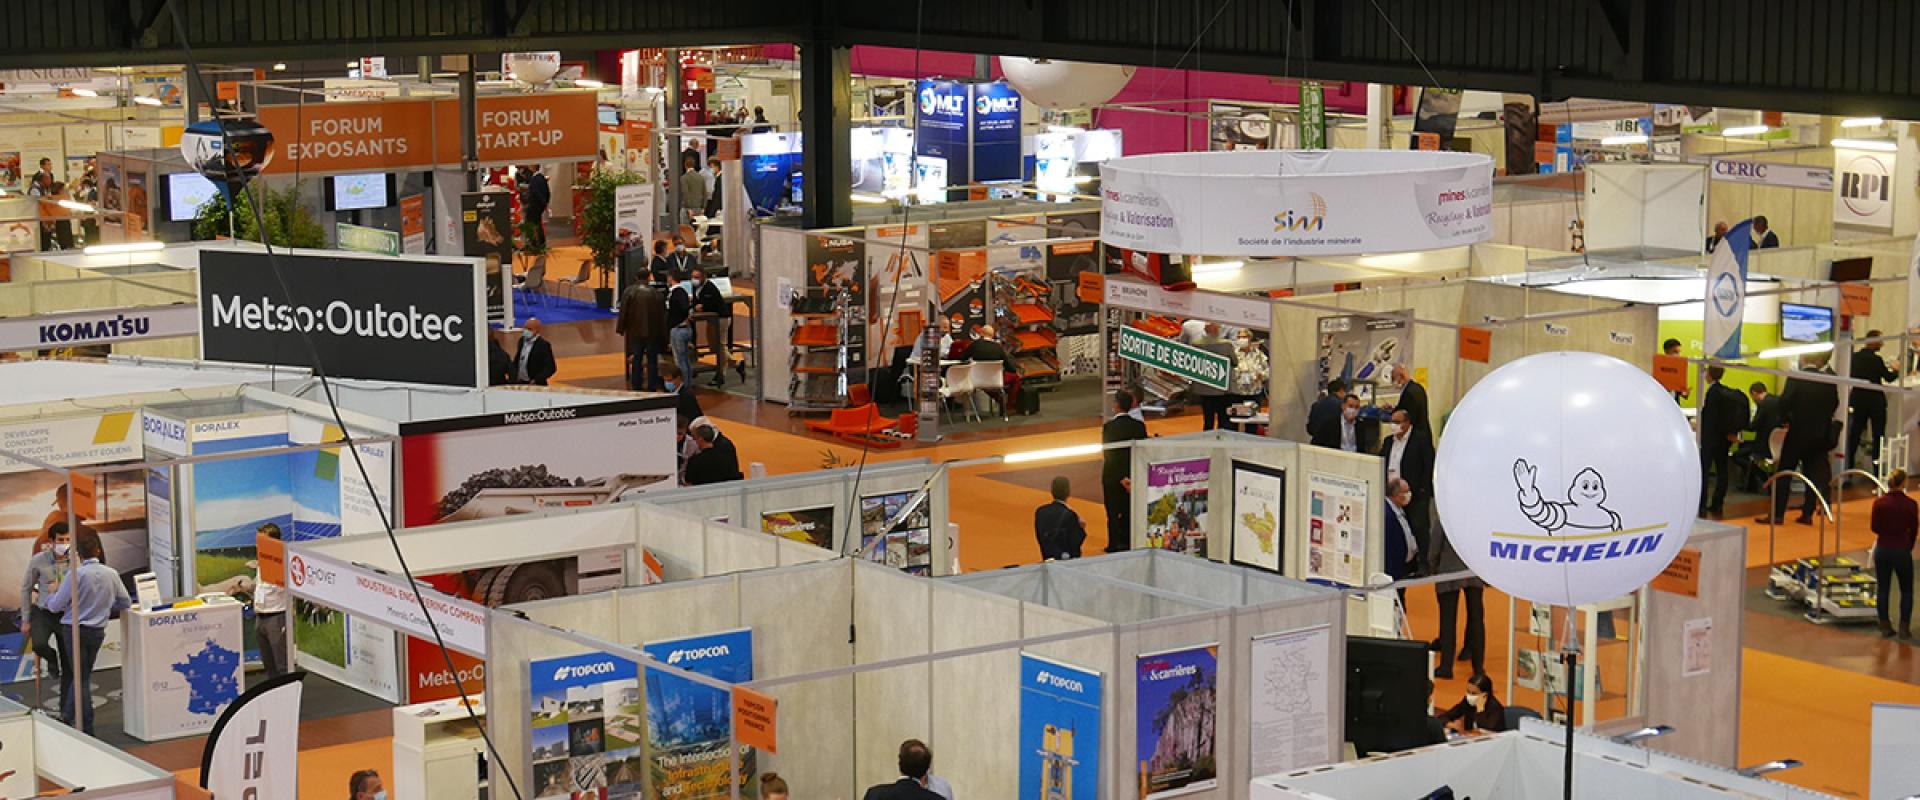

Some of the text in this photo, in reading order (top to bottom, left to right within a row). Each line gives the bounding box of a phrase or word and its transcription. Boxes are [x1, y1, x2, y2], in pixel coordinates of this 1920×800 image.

[311, 117, 383, 136] FORUM
[482, 109, 550, 128] FORUM
[287, 138, 408, 160] EXPOSANTS
[1715, 159, 1768, 178] CERIC
[1127, 211, 1173, 228] Valorisation
[1238, 237, 1268, 246] Société
[1270, 237, 1282, 246] de
[212, 294, 463, 342] Metso:Outotec
[39, 314, 150, 343] KOMATSU
[1121, 333, 1218, 380] SORTIE DE SECOURS
[504, 408, 577, 424] Metso:Outotec
[144, 416, 186, 442] BORALEX
[194, 421, 240, 434] BORALEX
[1489, 533, 1664, 563] MICHELIN
[306, 565, 336, 584] CHOVET
[356, 576, 398, 598] INDUSTRIAL
[150, 612, 197, 628] BORALEX
[684, 645, 729, 661] TOPCON
[570, 661, 615, 678] TOPCON
[1048, 675, 1083, 693] TOPCON
[658, 755, 678, 768] The
[662, 784, 682, 796] and
